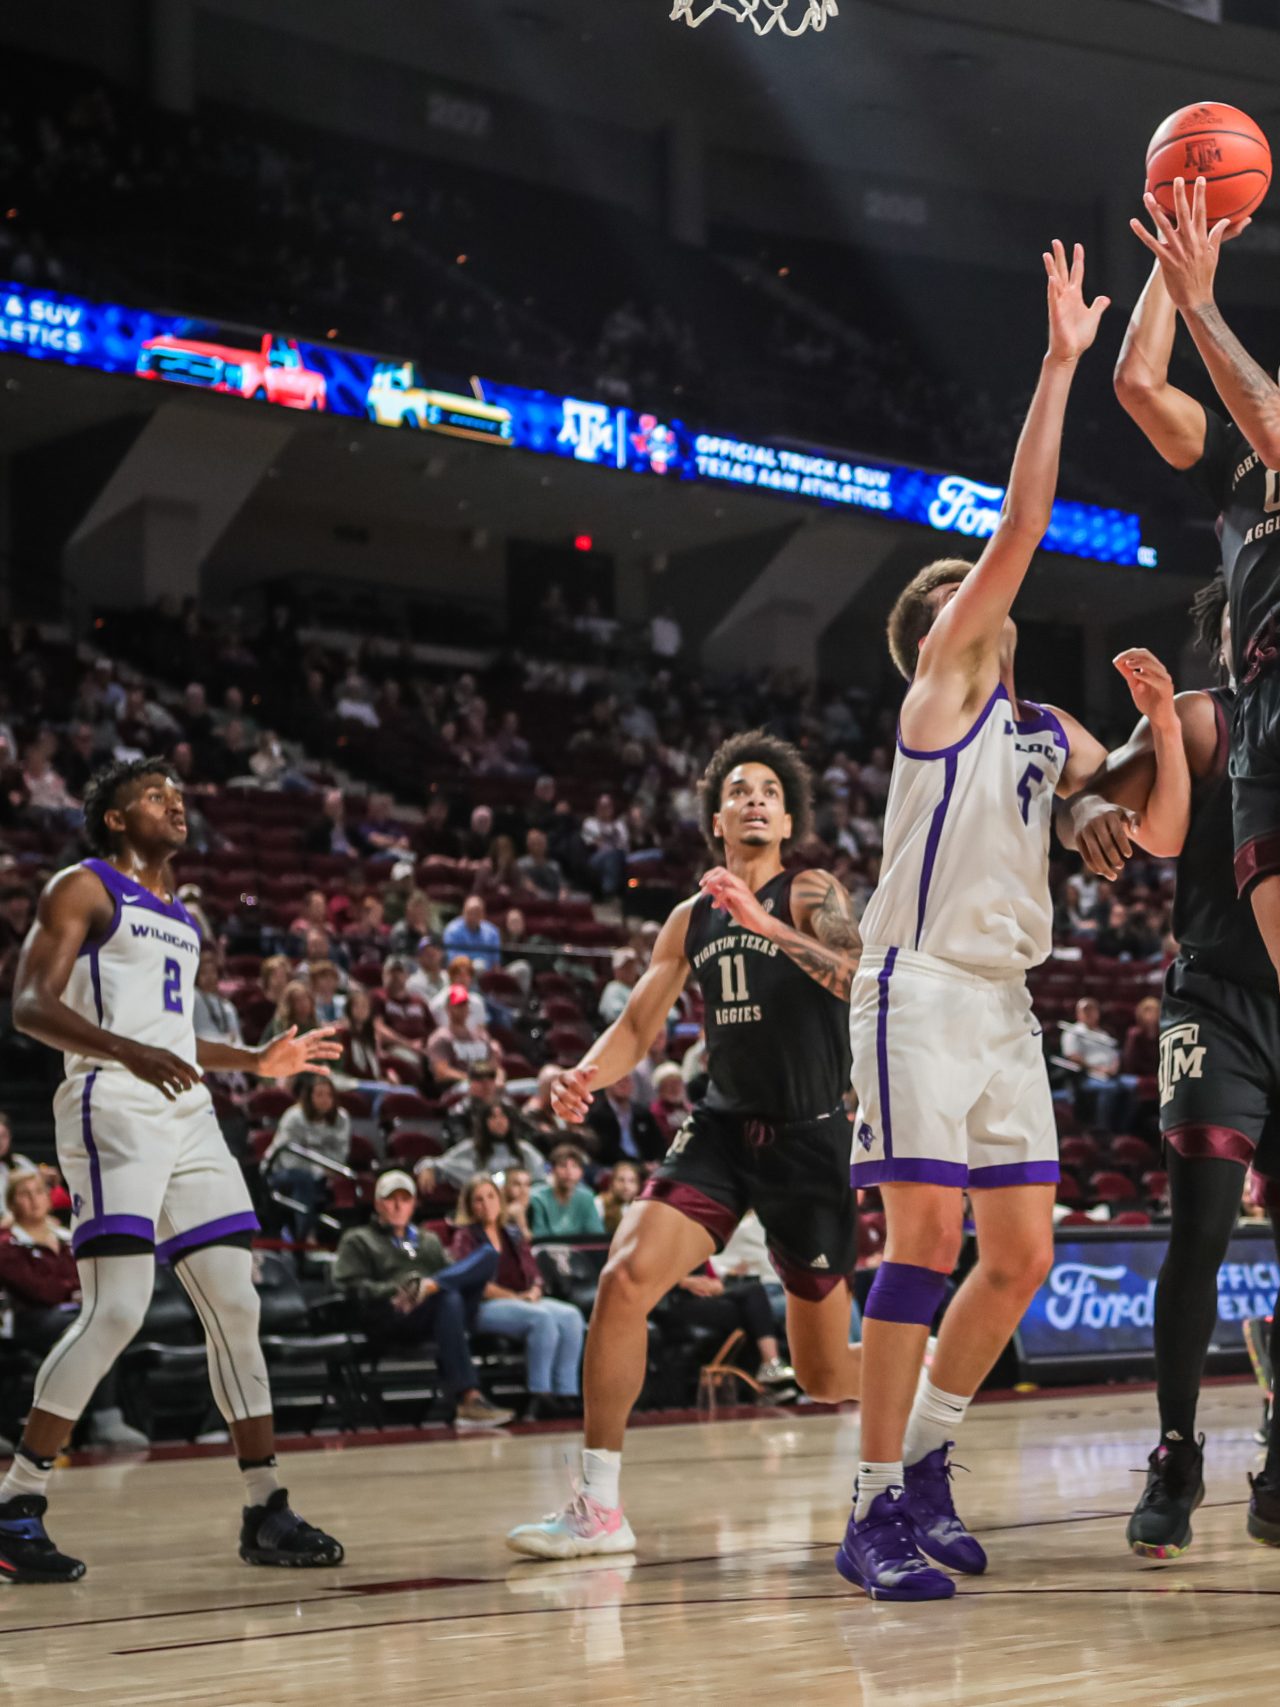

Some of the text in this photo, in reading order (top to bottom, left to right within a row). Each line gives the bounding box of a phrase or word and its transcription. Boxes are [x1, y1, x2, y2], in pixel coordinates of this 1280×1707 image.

[29, 299, 82, 328] SUV
[694, 455, 755, 485] TEXAS
[799, 476, 893, 511] ATHLETICS
[696, 433, 778, 469] OFFICIAL
[777, 450, 837, 478] TRUCK
[853, 466, 891, 489] SUV
[927, 475, 1006, 536] For
[740, 933, 780, 958] TEXAS
[163, 956, 184, 1015] 2
[718, 953, 749, 1002] 11
